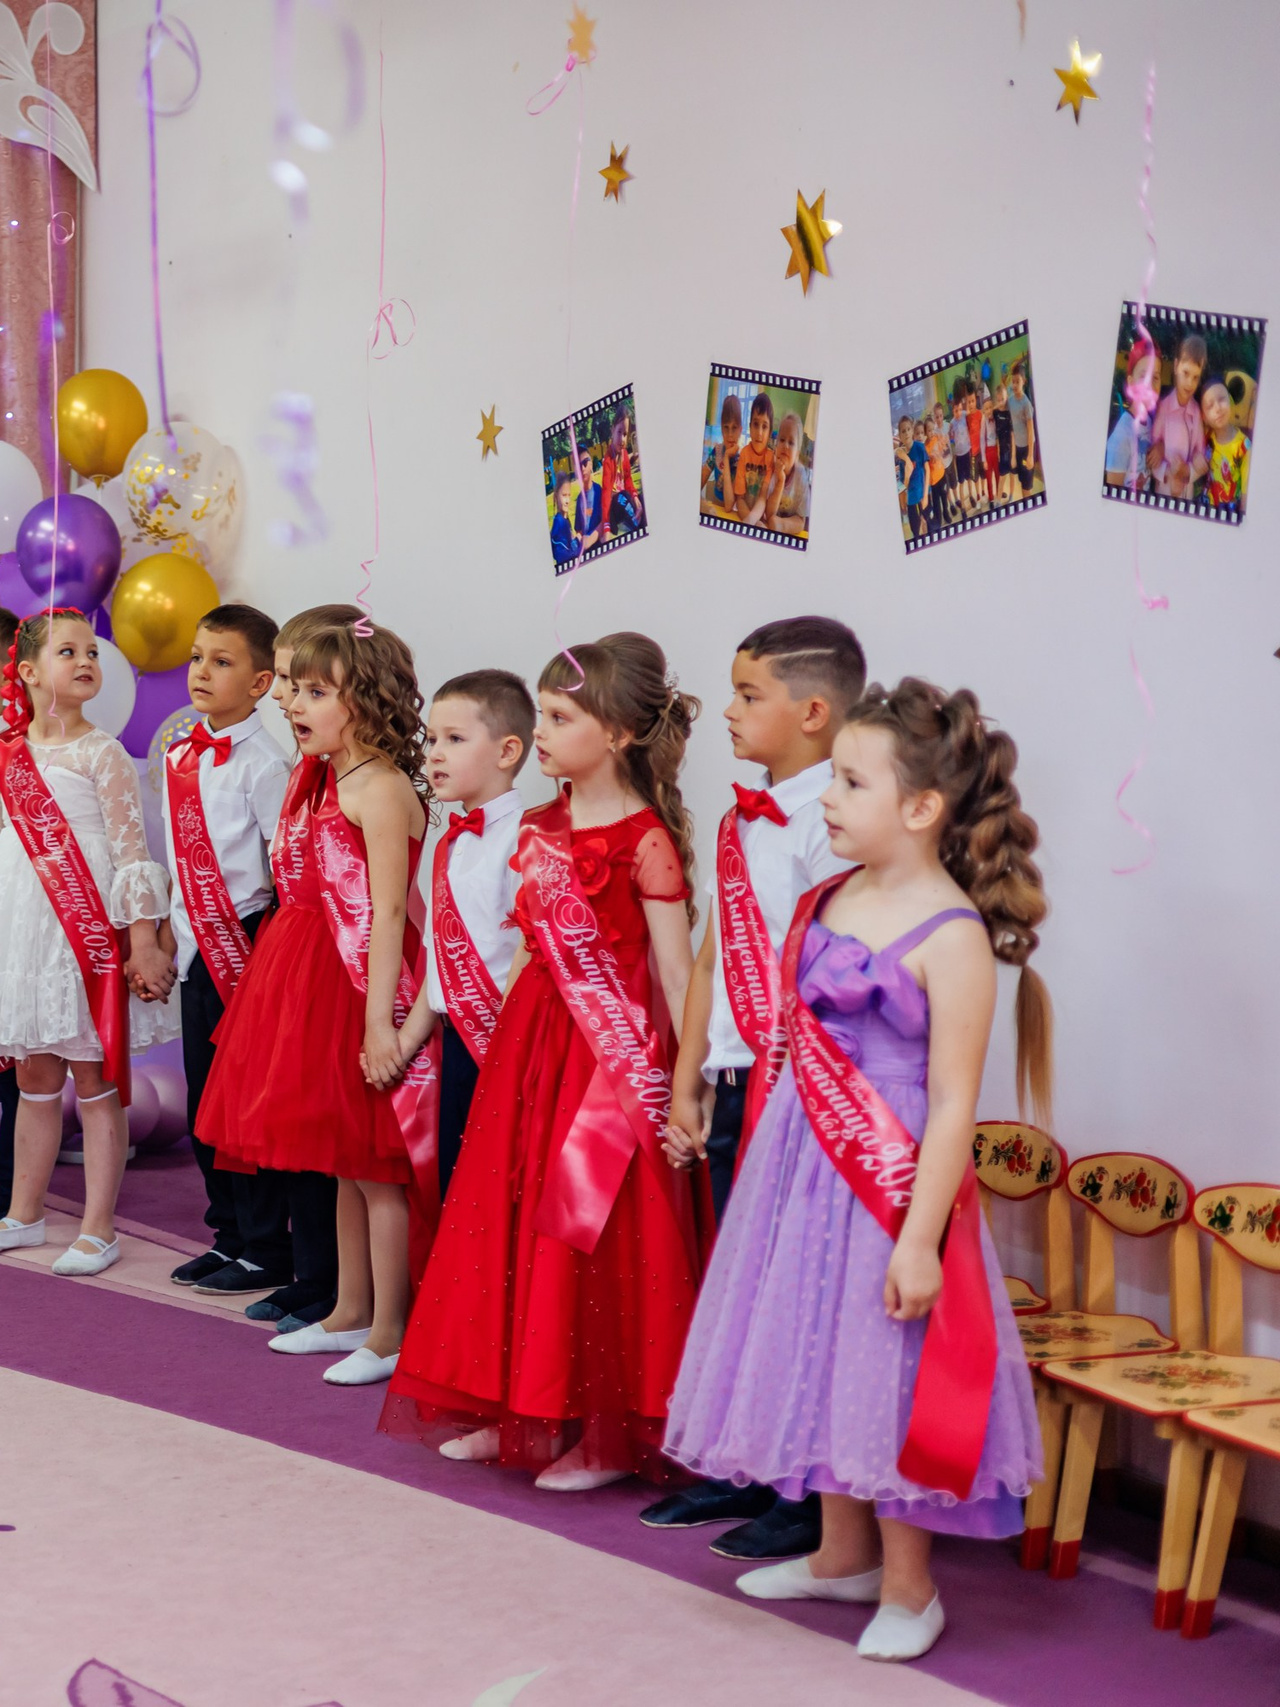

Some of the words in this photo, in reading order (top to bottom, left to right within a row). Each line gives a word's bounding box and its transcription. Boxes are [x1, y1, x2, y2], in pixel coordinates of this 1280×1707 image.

[11, 814, 39, 860] детского
[35, 855, 52, 879] сада
[24, 792, 93, 922] Выпускница
[75, 920, 118, 976] 2024
[176, 857, 196, 906] детского
[192, 908, 205, 936] сада
[321, 890, 351, 943] детского
[346, 944, 364, 974] сада
[722, 845, 772, 1022] Выпускник
[448, 988, 465, 1019] сада
[534, 918, 573, 983] детского
[570, 982, 590, 1015] сада
[553, 893, 649, 1072] Выпускница
[628, 1004, 649, 1042] Анна
